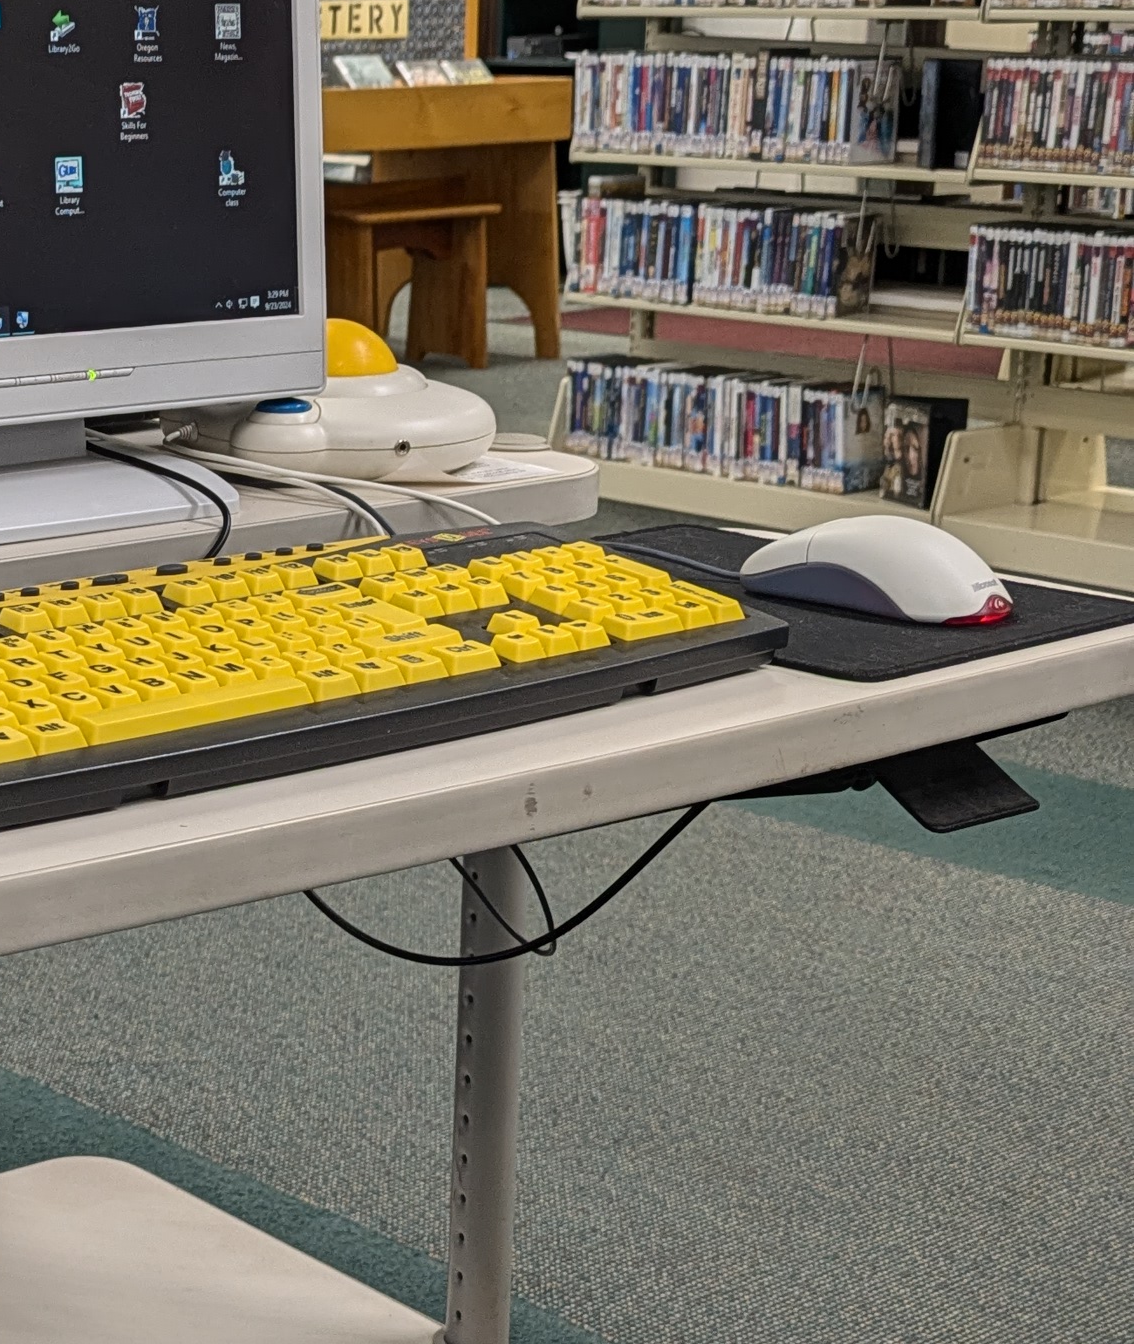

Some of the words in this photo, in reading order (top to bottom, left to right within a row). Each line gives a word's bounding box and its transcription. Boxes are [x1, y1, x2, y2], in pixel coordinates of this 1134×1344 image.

[321, 3, 403, 36] TERY
[136, 42, 159, 54] Oregon
[133, 53, 163, 63] Resources
[121, 121, 136, 131] Skills
[136, 121, 147, 130] For
[120, 131, 149, 143] Beginners
[217, 188, 247, 198] Computer
[59, 196, 80, 206] Library
[225, 198, 239, 207] class
[7, 657, 38, 668] R
[46, 649, 71, 659] T
[85, 642, 110, 653] Y
[124, 636, 151, 646] U
[200, 624, 225, 633] O
[234, 618, 255, 627] P
[7, 678, 34, 688] D
[47, 671, 69, 681] F
[88, 663, 118, 673] G
[126, 657, 155, 666] H
[171, 651, 190, 661] J
[203, 643, 232, 653] K
[239, 639, 266, 647] L
[16, 698, 49, 709] X
[61, 691, 88, 701] C
[98, 684, 123, 694] V
[137, 677, 166, 687] B
[177, 670, 207, 681] N
[213, 662, 246, 673] M
[383, 630, 427, 643] Shift
[35, 722, 66, 733] Alt
[310, 669, 340, 679] Alt
